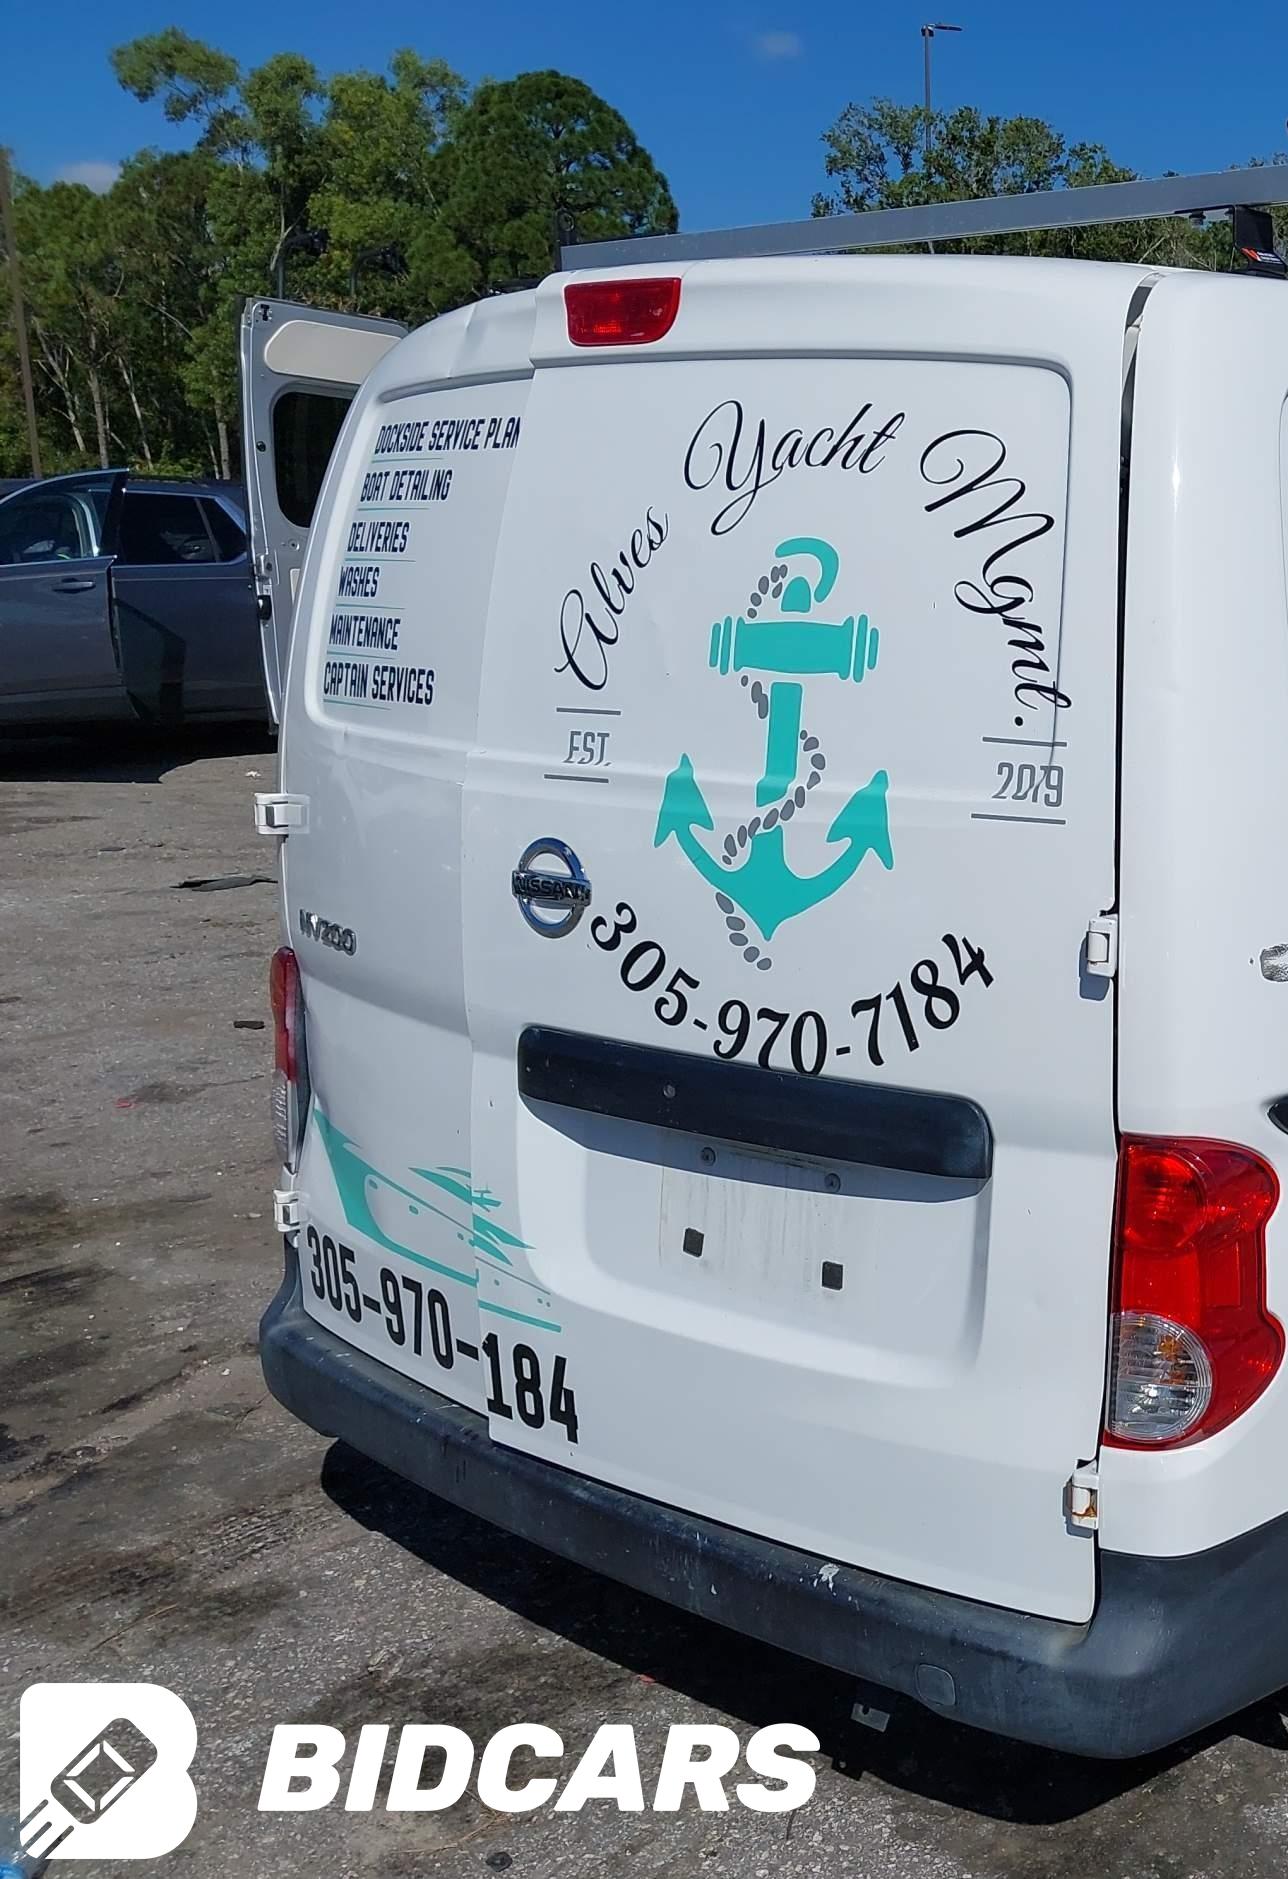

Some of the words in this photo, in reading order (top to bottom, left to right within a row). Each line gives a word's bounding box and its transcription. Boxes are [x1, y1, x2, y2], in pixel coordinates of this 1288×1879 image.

[374, 420, 430, 455] DOCKSIDE
[428, 417, 486, 451] SERVICE
[361, 470, 391, 502] BOAT
[389, 468, 453, 501] DETAILING
[346, 521, 411, 553] DELIVERIES
[338, 566, 380, 598] WASHES
[554, 506, 670, 691] Alves
[684, 399, 905, 536] Yacht
[919, 428, 1073, 727] Mgmt.
[328, 613, 401, 651] MAINTENANCE
[323, 661, 369, 698] CAPTAIN
[371, 664, 435, 706] SERVICES
[991, 761, 1064, 808] 2019
[513, 873, 591, 903] NISSAN
[590, 901, 995, 1077] 305-970-7184
